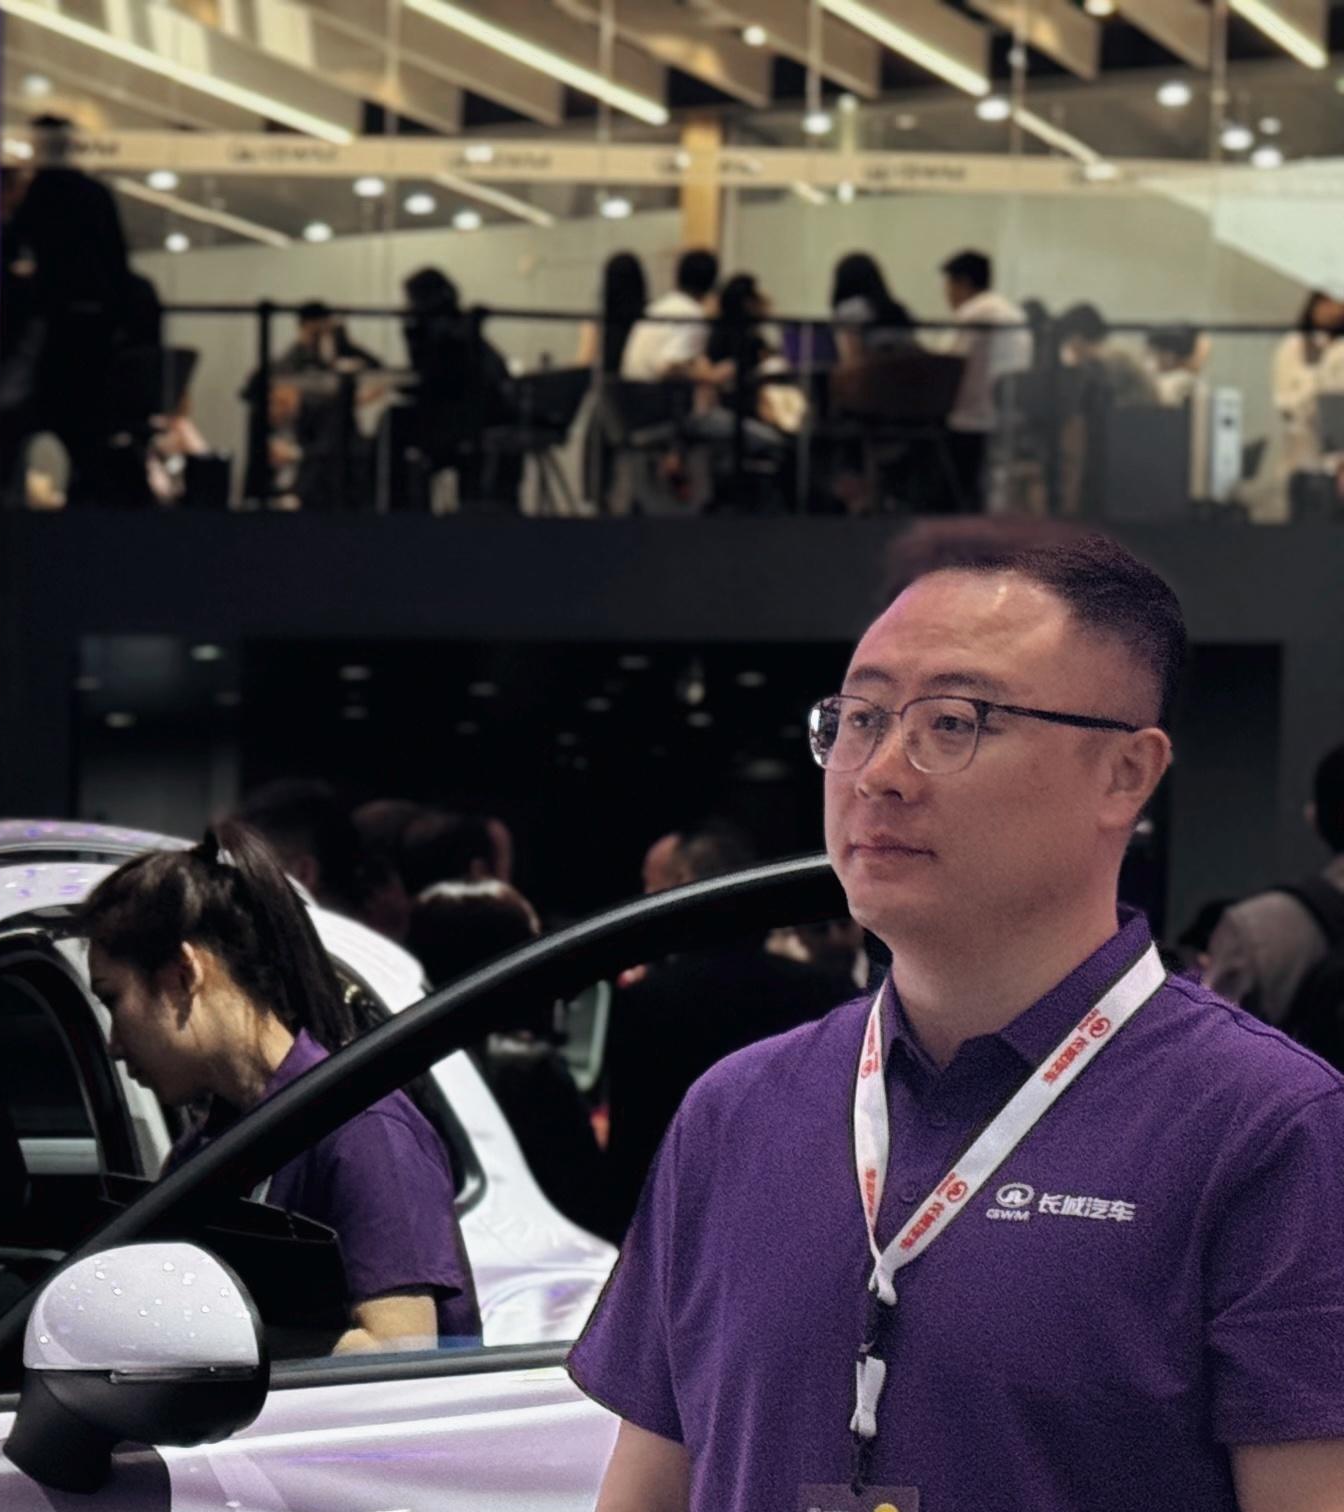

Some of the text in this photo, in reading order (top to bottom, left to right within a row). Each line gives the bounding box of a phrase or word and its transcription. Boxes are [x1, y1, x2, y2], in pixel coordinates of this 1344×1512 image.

[986, 1208, 1031, 1222] GWM
[1038, 1192, 1136, 1222] 长城汽车
